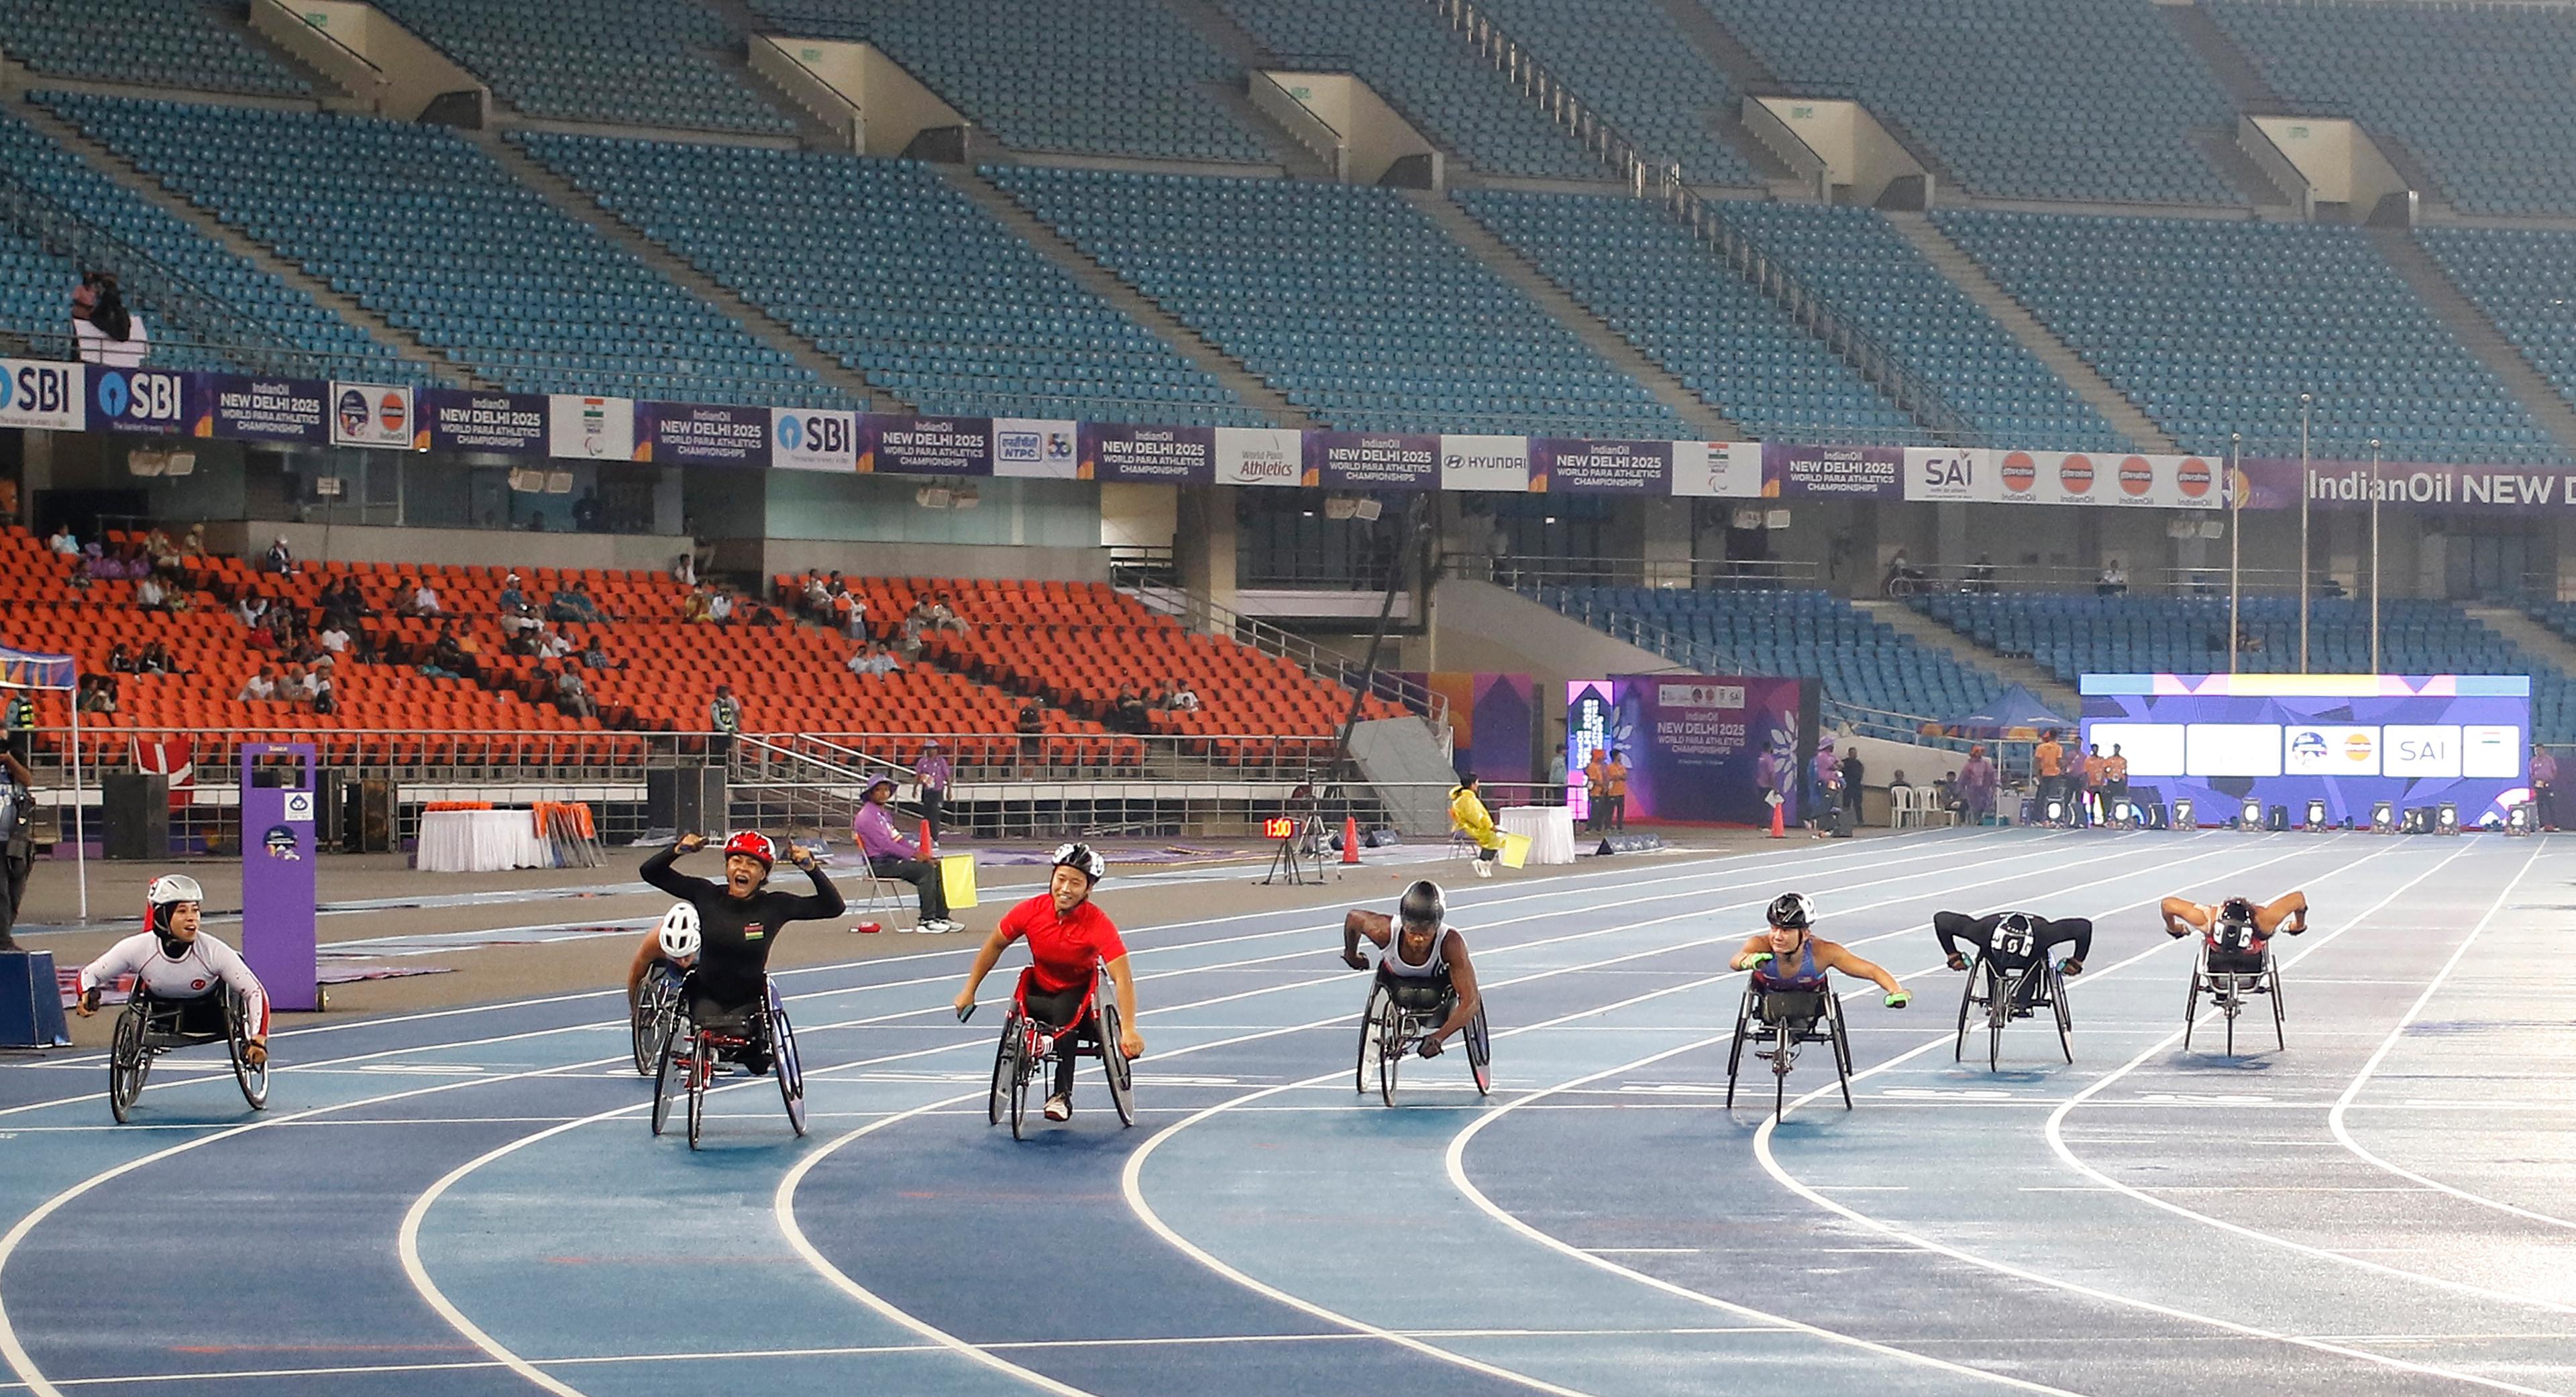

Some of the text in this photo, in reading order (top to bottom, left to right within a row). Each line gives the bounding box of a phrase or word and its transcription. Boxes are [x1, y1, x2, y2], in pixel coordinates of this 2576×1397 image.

[17, 367, 69, 414] SBI
[130, 373, 181, 421] SBI
[221, 393, 321, 412] NEW DELHI 2025
[222, 408, 320, 425] WORLD PARA ATHLETICS
[440, 408, 541, 427] NEW DELHI 2025
[237, 421, 305, 434] CHAMPIONSHIPS
[441, 423, 541, 438] WORLD PARA ATHLETICS
[661, 420, 761, 437] NEW DELHI 2025
[458, 435, 525, 447] CHAMPIONSHIPS
[806, 416, 850, 453] SBI
[882, 432, 984, 447] NEW DELHI 2025
[1135, 431, 1173, 442] IndianOil
[661, 435, 762, 449] WORLD PARA ATHLETICS
[1102, 441, 1205, 456] NEW DELHI 2025
[1362, 438, 1399, 449] IndianOil
[678, 445, 746, 457] CHAMPIONSHIPS
[883, 446, 984, 458] WORLD PARA ATHLETICS
[1005, 449, 1035, 457] NTPC
[1242, 450, 1283, 459] World Para
[1328, 449, 1432, 463] NEW DELHI 2025
[1591, 445, 1629, 455] IndianOil
[1823, 451, 1862, 461] IndianOil
[900, 457, 968, 467] CHAMPIONSHIPS
[1104, 455, 1205, 466] WORLD PARA ATHLETICS
[1468, 456, 1526, 469] HYUNDAI
[1556, 455, 1662, 469] NEW DELHI 2025
[1120, 465, 1188, 475] CHAMPIONSHIPS
[1240, 461, 1293, 477] Athletics
[1330, 462, 1432, 473] WORLD PARA ATHLETICS
[1557, 468, 1661, 478] WORLD PARA ATHLETICS
[1790, 461, 1894, 474] NEW DELHI 2025
[1925, 459, 1972, 486] SAI
[1346, 471, 1415, 482] CHAMPIONSHIPS
[1574, 477, 1644, 488] CHAMPIONSHIPS
[1790, 473, 1894, 484] WORLD PARA ATHLETICS
[1807, 483, 1878, 492] CHAMPIONSHIPS
[2310, 470, 2451, 502] IndianOil
[2463, 475, 2554, 505] NEW
[2001, 493, 2036, 502] IndianOil
[2060, 495, 2095, 504] IndianOil
[2118, 496, 2154, 506] IndianOil
[2177, 498, 2212, 507] IndianOil
[1657, 722, 1745, 736] NEW DELHI 2025
[1658, 735, 1685, 744] WORLD
[1705, 736, 1745, 746] ATHLETICS
[2400, 741, 2445, 761] SAI
[2176, 804, 2191, 820] 7
[2376, 807, 2390, 824] 4
[2440, 808, 2454, 825] 3
[2510, 809, 2524, 826] 2
[1265, 819, 1292, 838] 1:00
